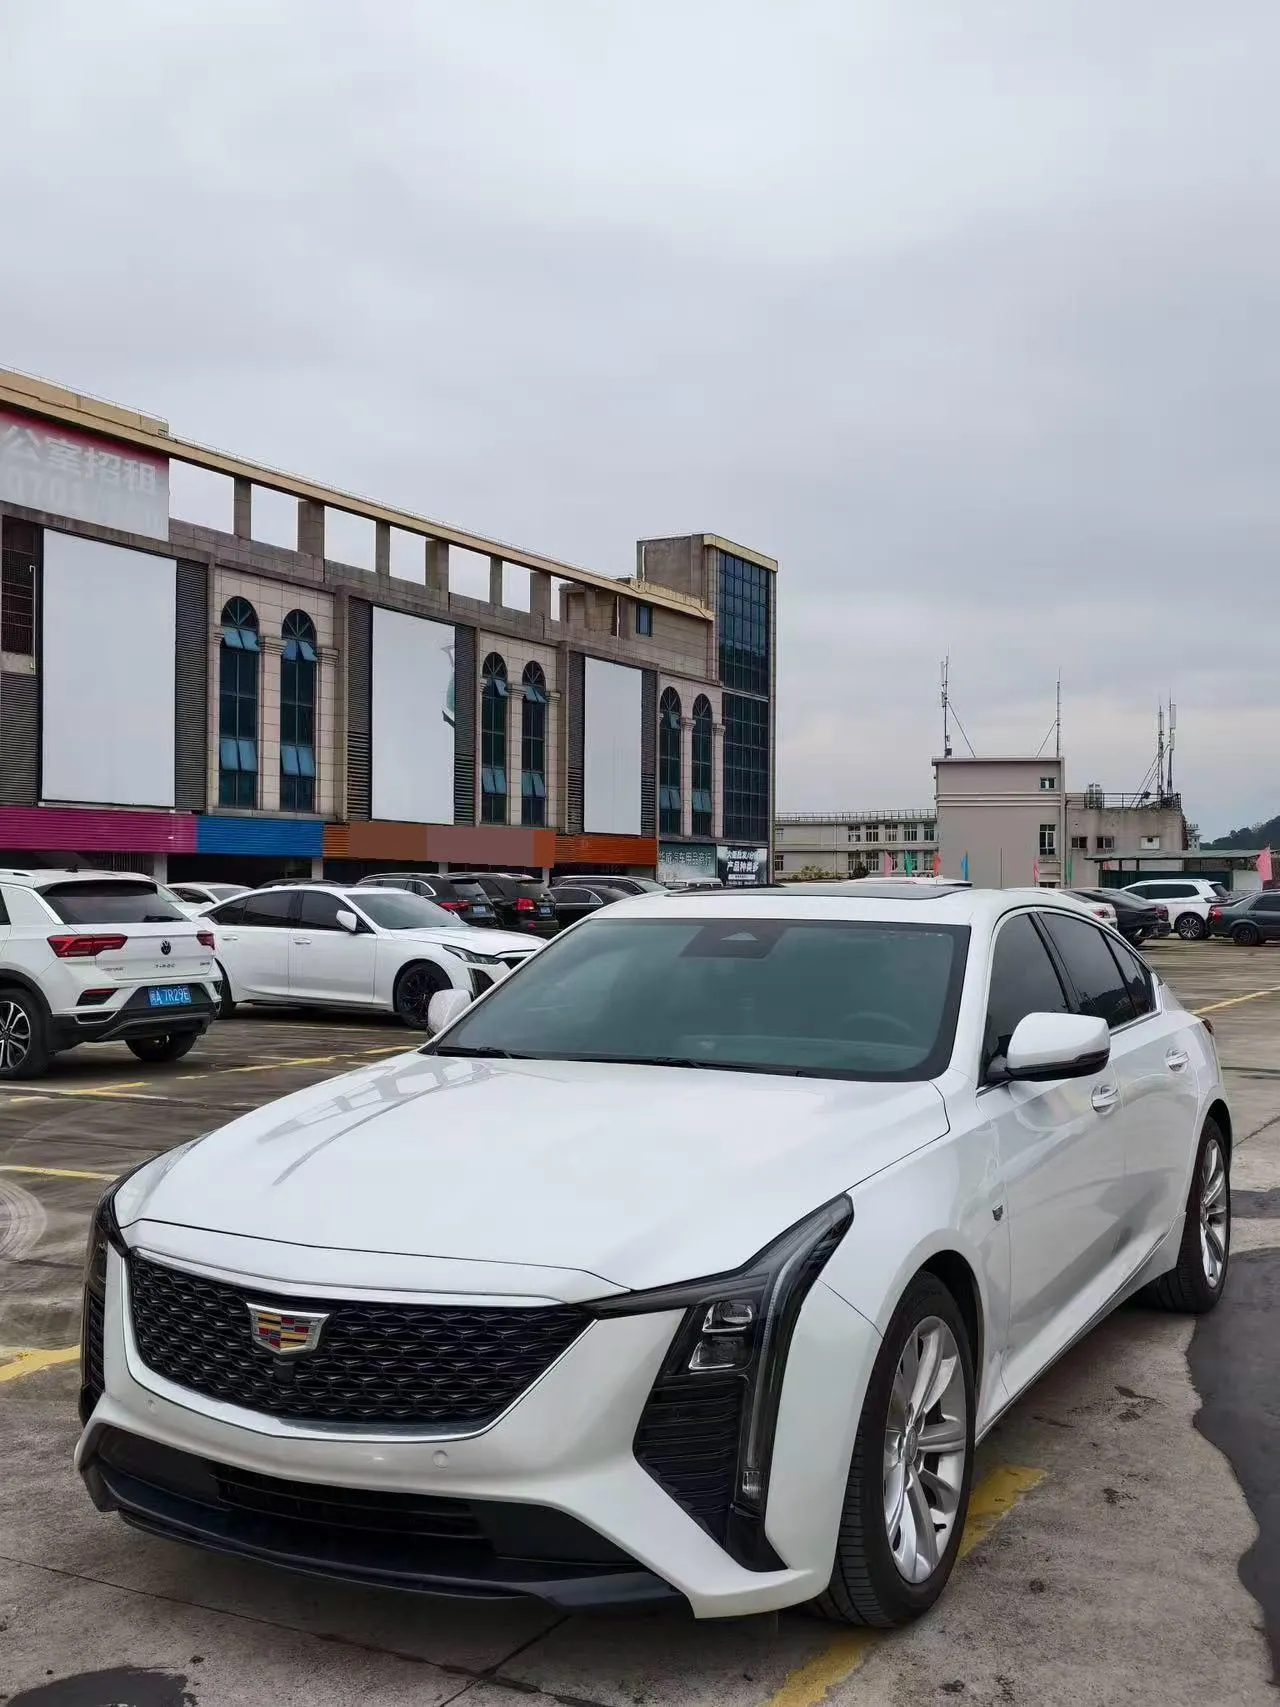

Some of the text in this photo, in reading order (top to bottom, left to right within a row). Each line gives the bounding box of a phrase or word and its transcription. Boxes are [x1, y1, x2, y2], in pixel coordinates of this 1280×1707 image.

[726, 860, 760, 873] 产品种类多
